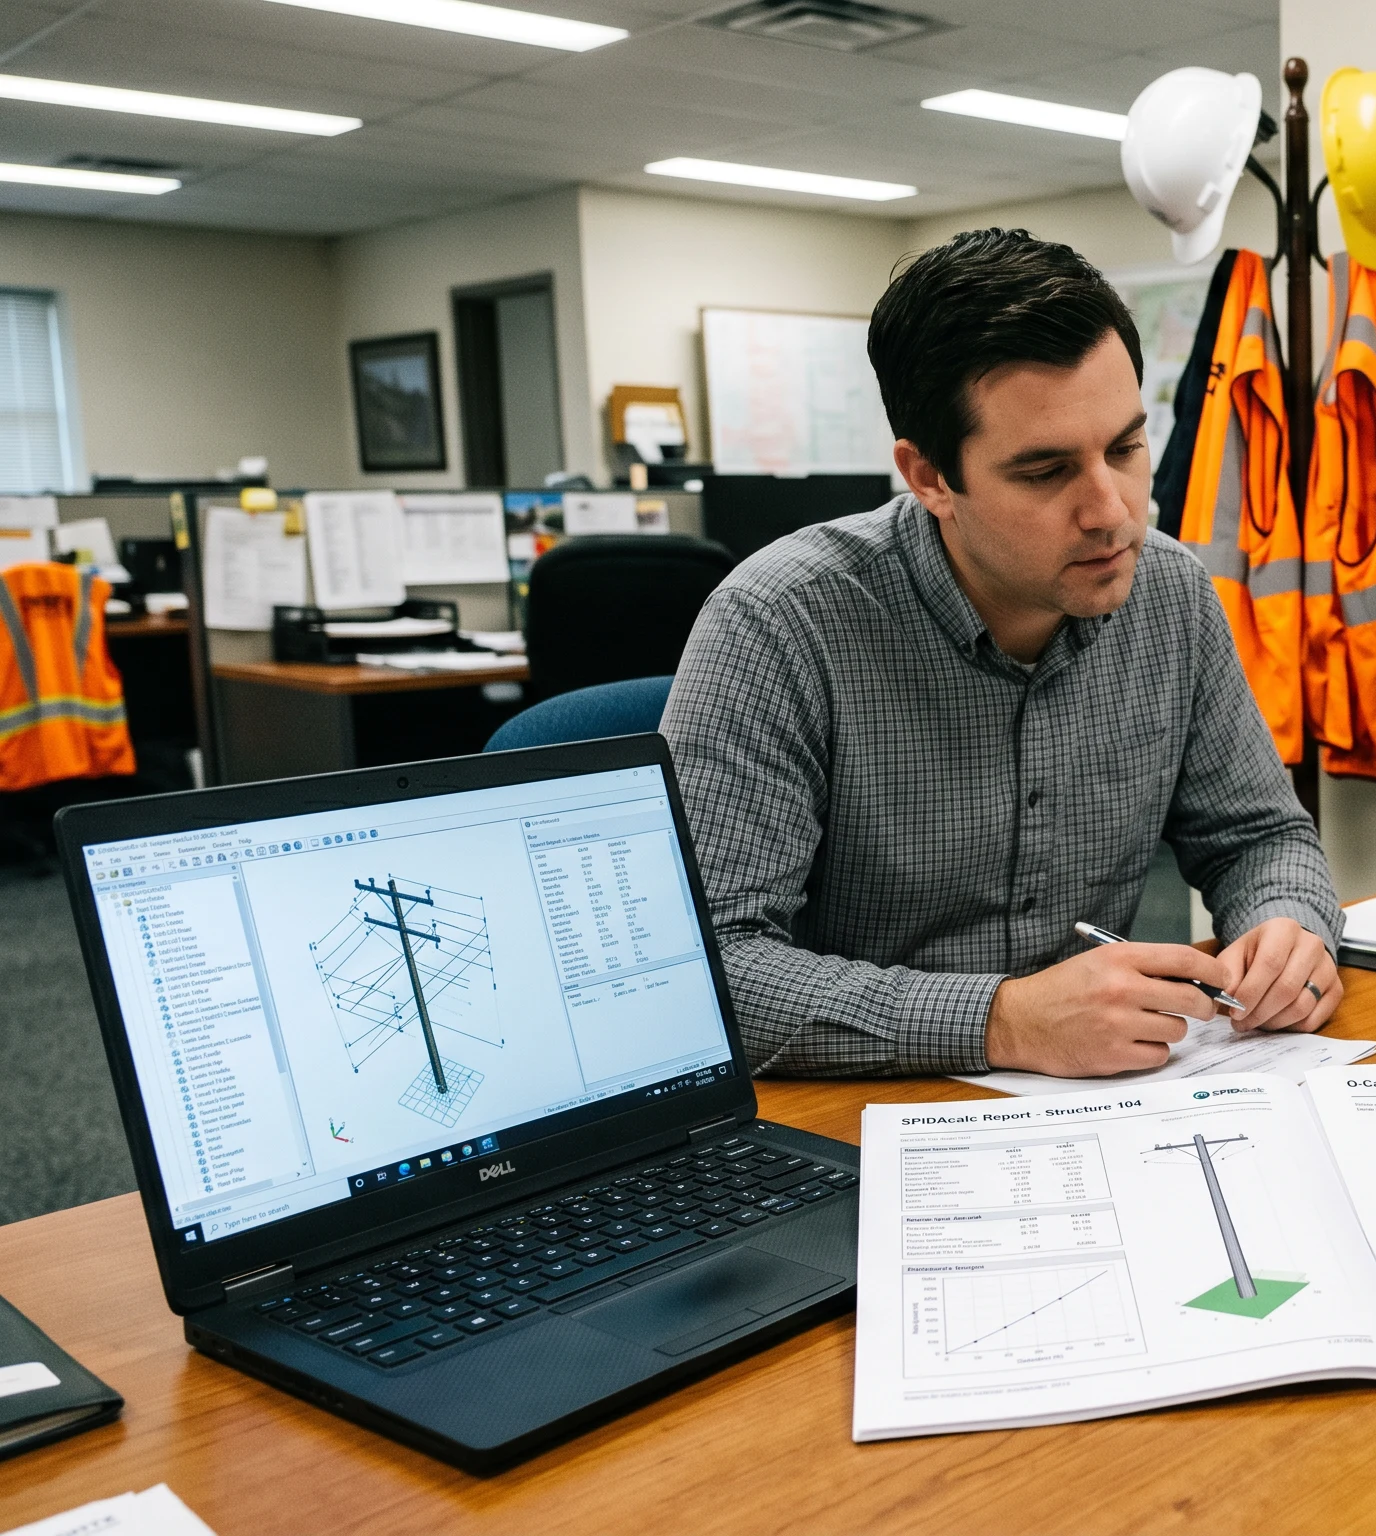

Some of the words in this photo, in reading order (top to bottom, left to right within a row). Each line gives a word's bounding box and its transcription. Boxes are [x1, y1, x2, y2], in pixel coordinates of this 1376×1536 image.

[901, 1115, 978, 1126] SPIDAcalc
[982, 1110, 1031, 1122] Report
[1045, 1104, 1112, 1117] Structure
[1117, 1099, 1143, 1109] 104
[478, 1160, 516, 1182] DELL
